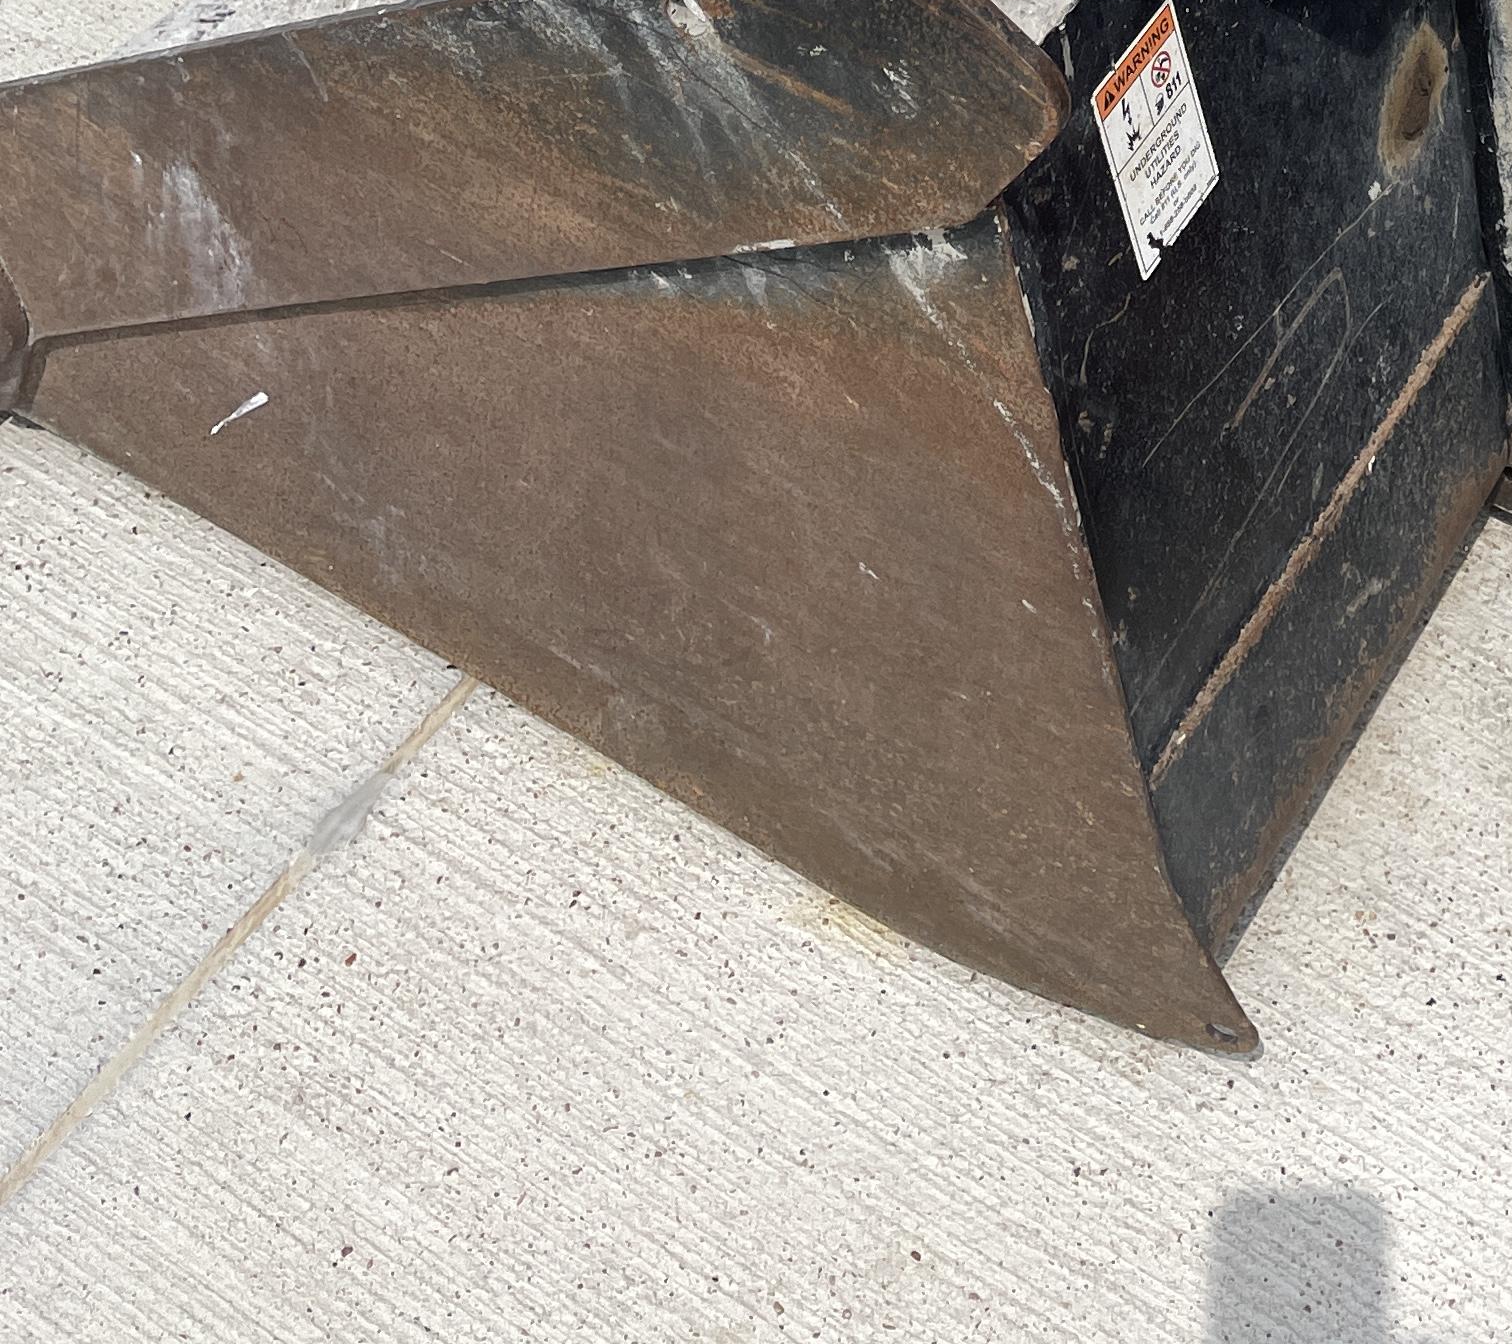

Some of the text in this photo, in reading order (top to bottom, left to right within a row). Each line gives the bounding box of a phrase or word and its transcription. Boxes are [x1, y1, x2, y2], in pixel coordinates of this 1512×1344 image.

[1112, 17, 1169, 92] WARNING
[1165, 70, 1181, 99] 811
[1129, 102, 1186, 181] UNDERGROUND
[1144, 129, 1179, 178] UTILITIES
[1149, 144, 1181, 189] HAZARD
[1139, 204, 1155, 225] CALL
